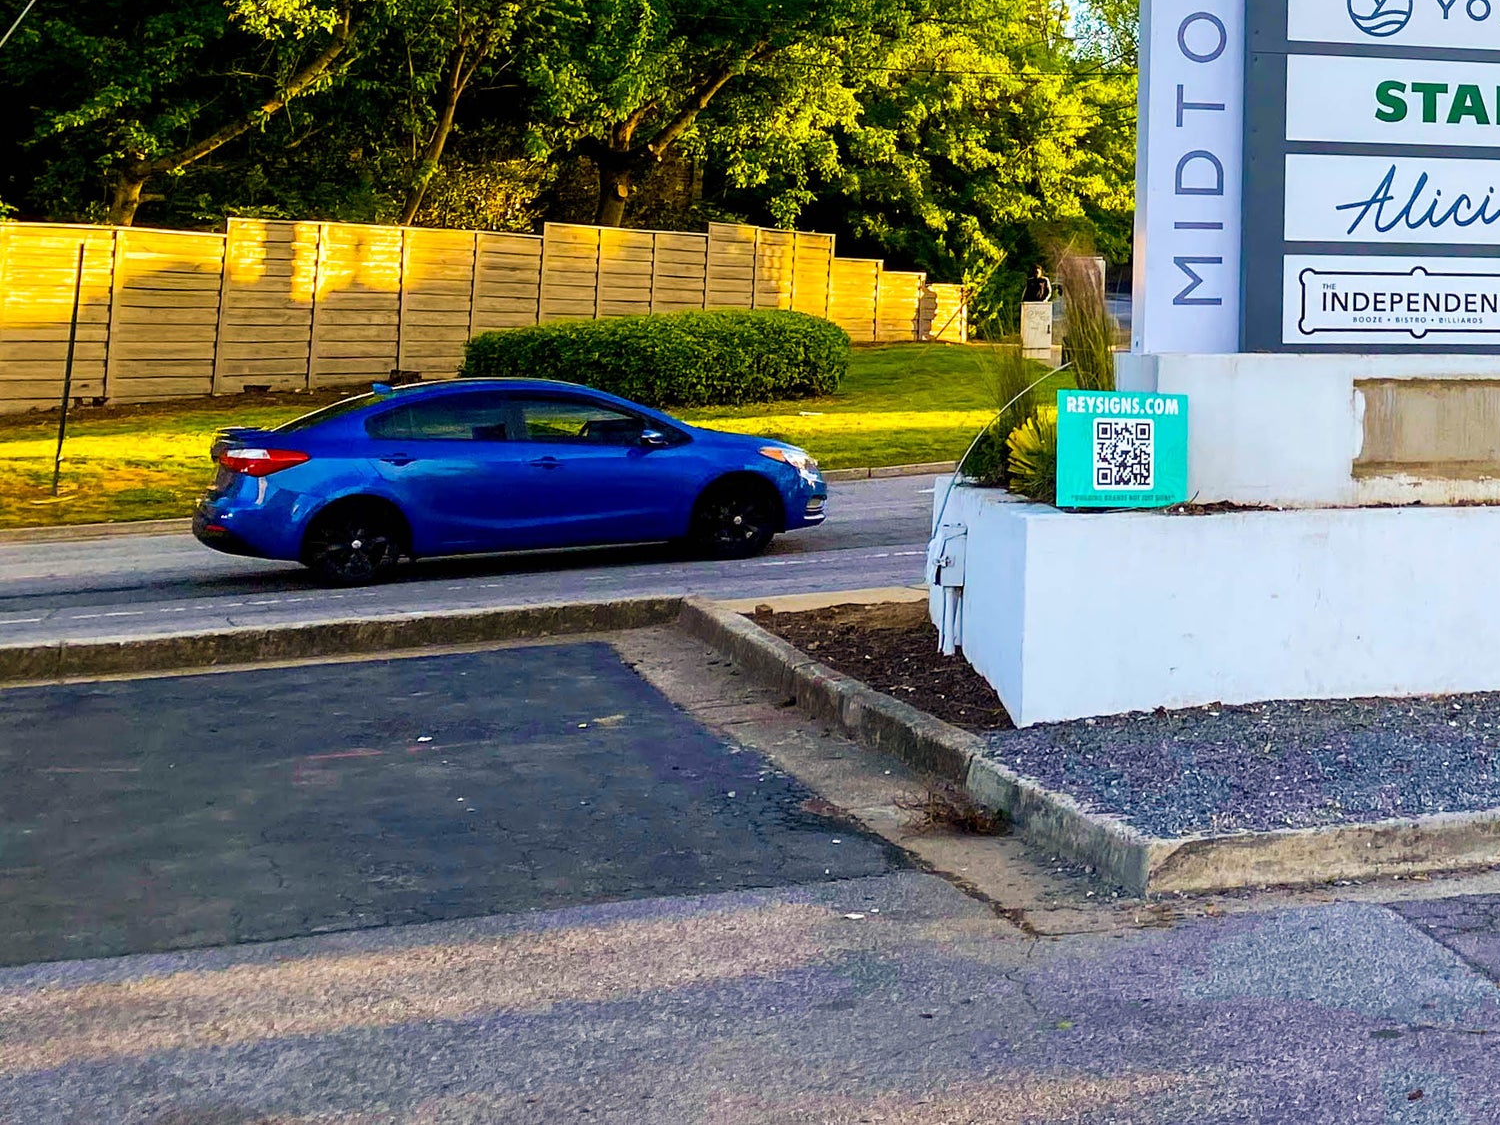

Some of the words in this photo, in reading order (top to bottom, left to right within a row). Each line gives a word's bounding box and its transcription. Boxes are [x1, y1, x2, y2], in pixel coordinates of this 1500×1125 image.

[1352, 316, 1383, 324] BOOZE
[1395, 316, 1427, 324] BISTRO
[1438, 316, 1484, 325] BILLIARDS
[1066, 396, 1179, 415] REYSIGNS.COM
